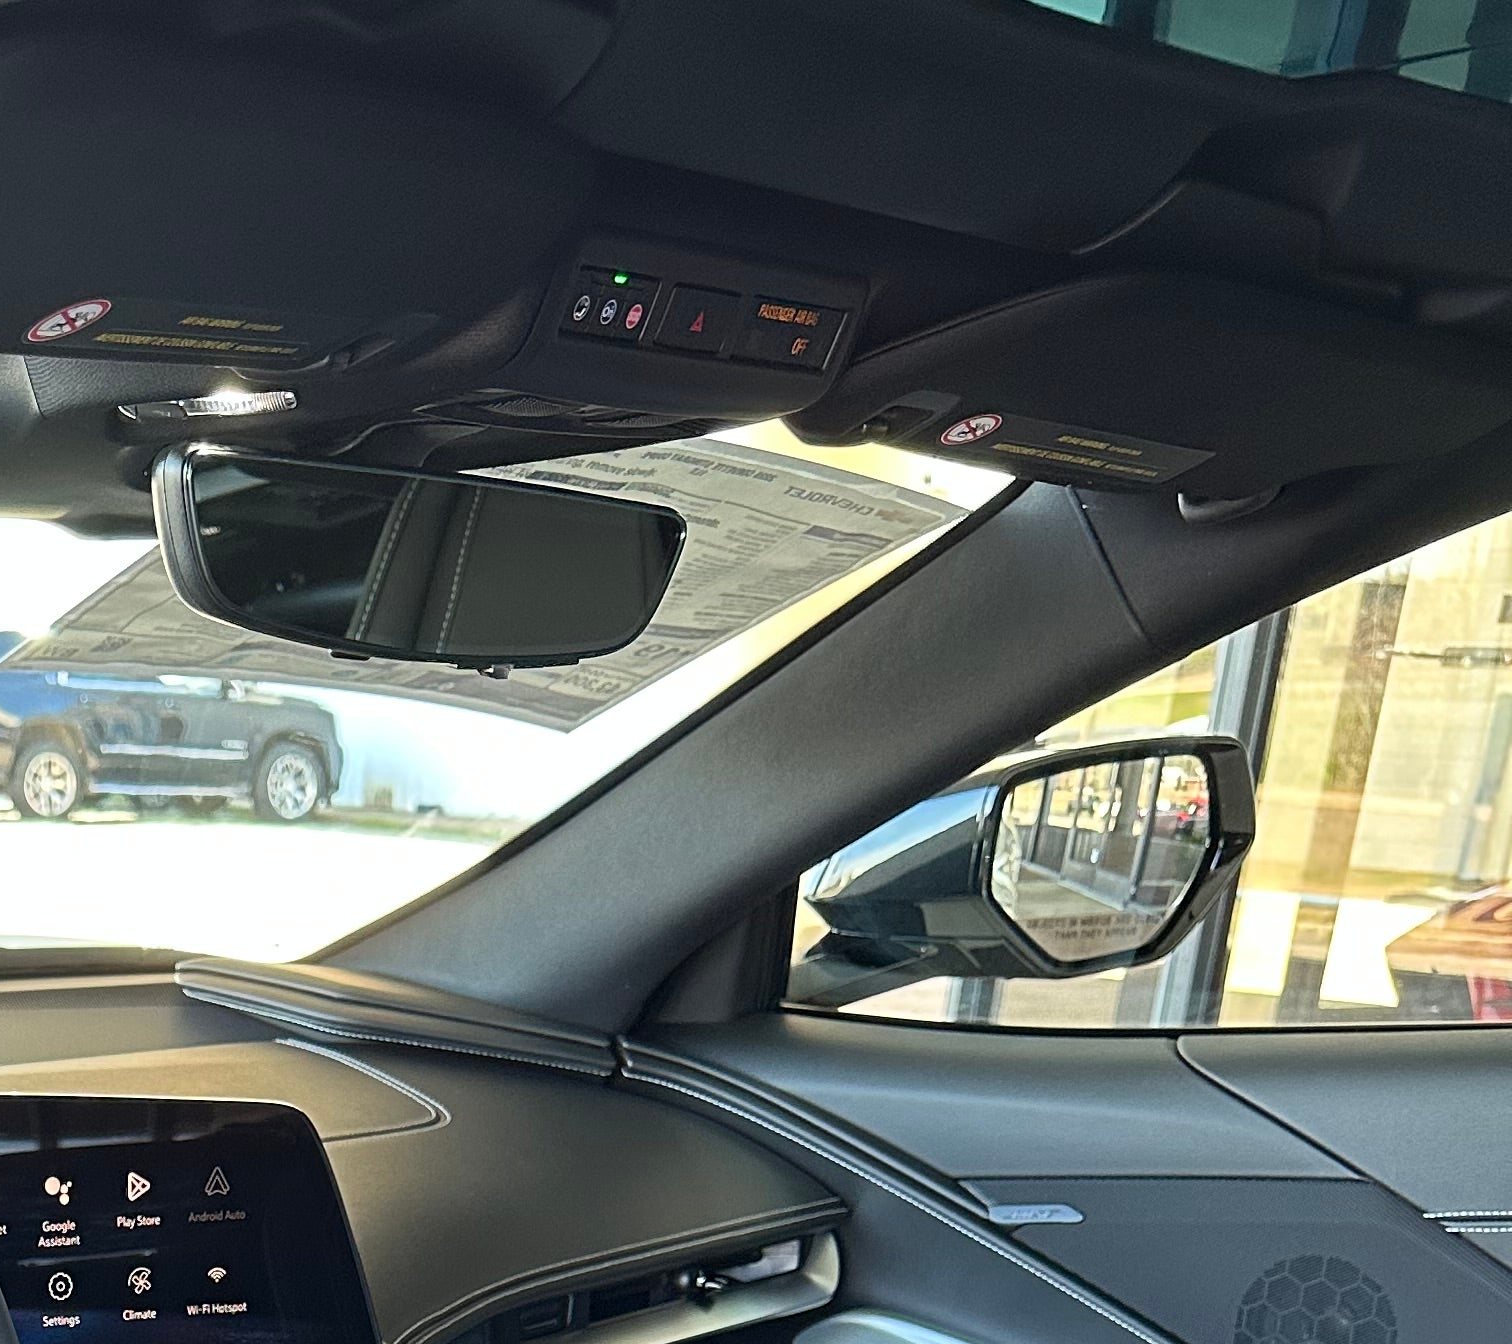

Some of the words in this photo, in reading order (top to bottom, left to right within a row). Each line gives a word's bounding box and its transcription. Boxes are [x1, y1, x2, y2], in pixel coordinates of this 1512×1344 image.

[791, 338, 809, 355] OFF
[117, 1216, 136, 1229] Play
[137, 1215, 161, 1227] Store
[188, 1211, 224, 1222] Android
[225, 1209, 247, 1221] Auto
[42, 1219, 76, 1233] Google
[38, 1235, 81, 1248] Assistant
[122, 1309, 157, 1321] Climate
[187, 1303, 210, 1316] Wi-Fi
[212, 1302, 248, 1315] Hotspot
[42, 1315, 80, 1328] Settings
